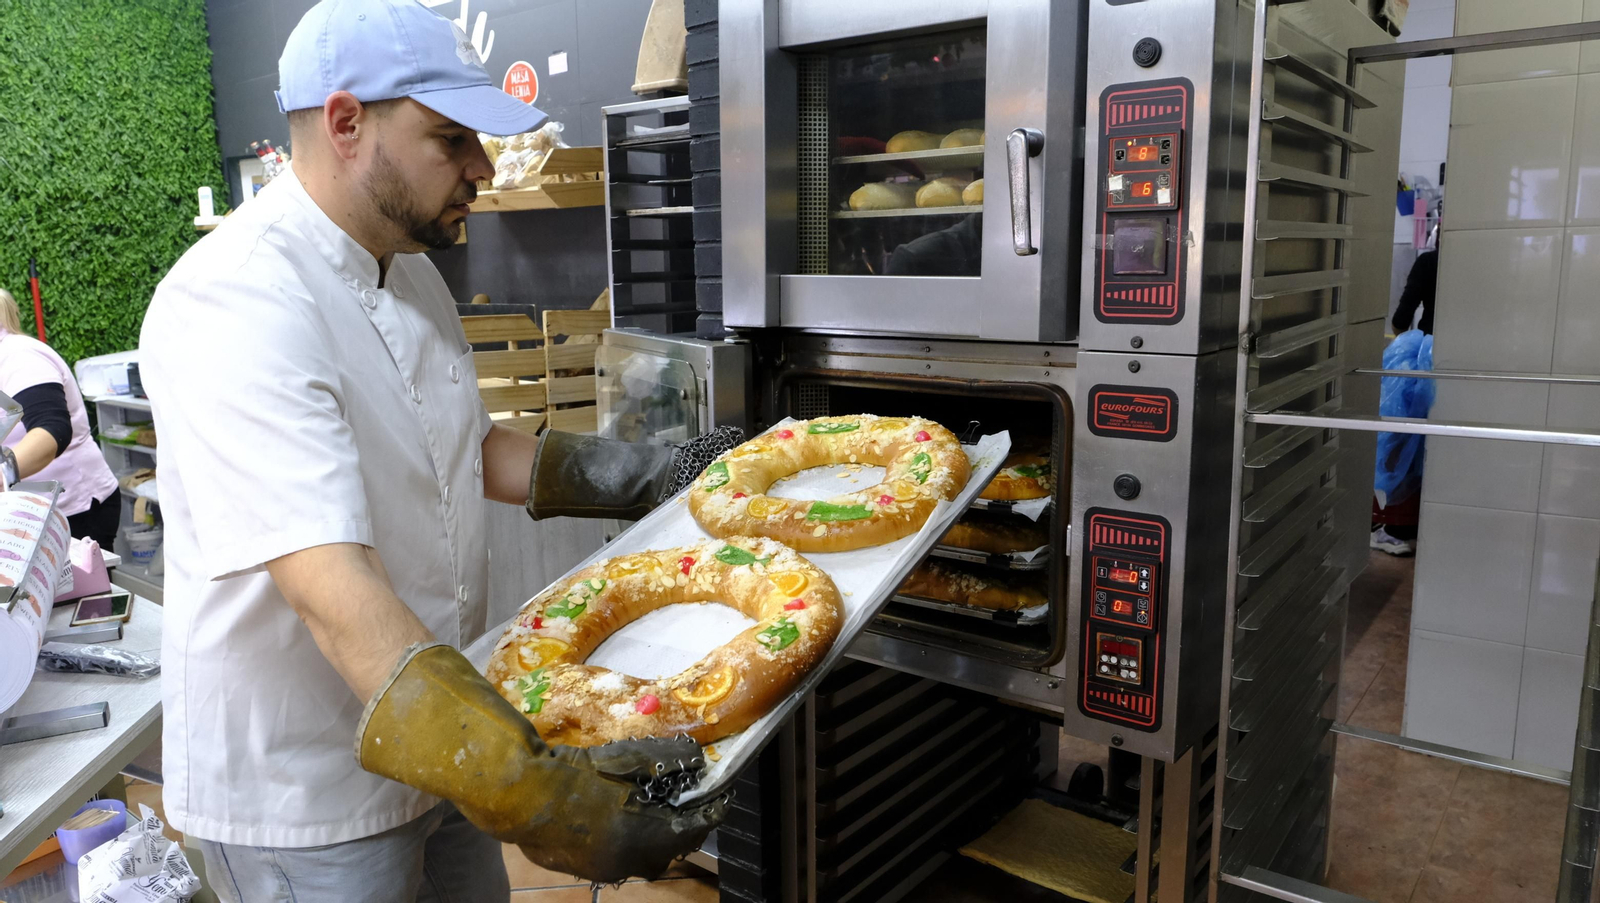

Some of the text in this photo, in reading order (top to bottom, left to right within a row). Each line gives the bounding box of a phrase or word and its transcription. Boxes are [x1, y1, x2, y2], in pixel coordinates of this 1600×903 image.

[511, 70, 529, 84] MASA
[1139, 147, 1148, 160] 8
[1142, 182, 1151, 195] 6
[1114, 600, 1121, 611] 0
